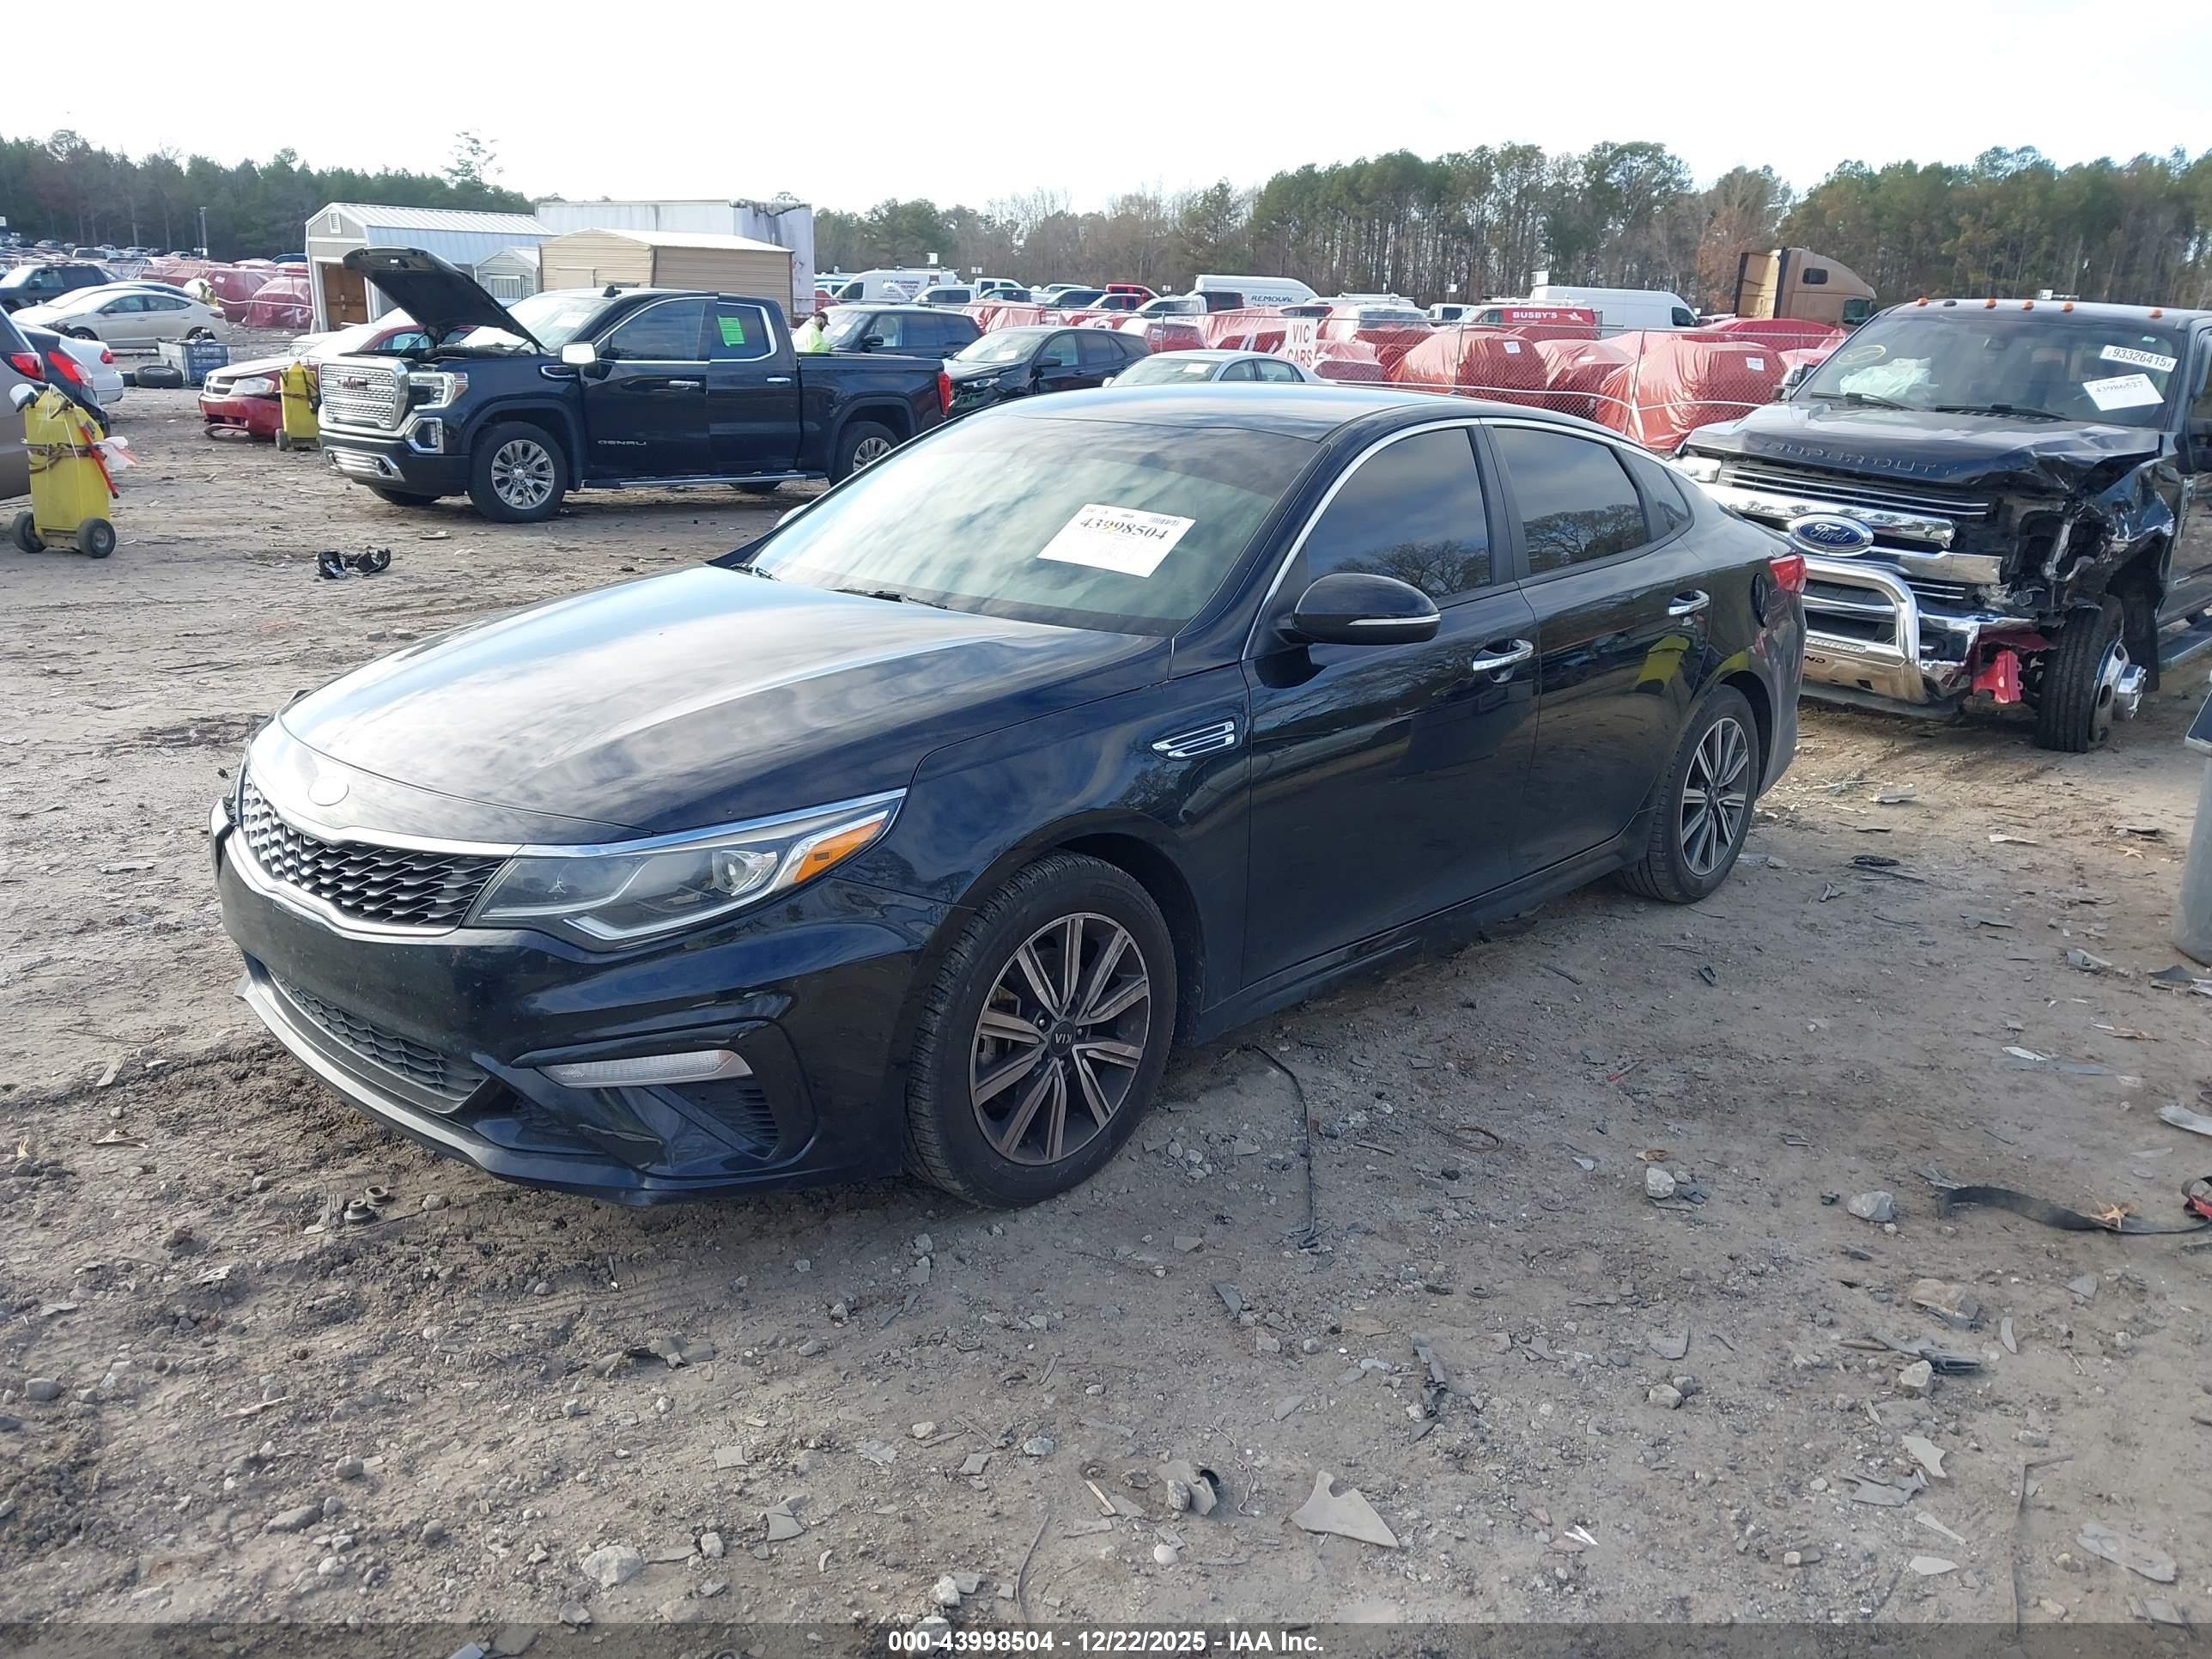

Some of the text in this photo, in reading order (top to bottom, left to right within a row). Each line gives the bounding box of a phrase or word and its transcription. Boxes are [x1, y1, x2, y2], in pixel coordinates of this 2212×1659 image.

[1250, 295, 1295, 303] REMOVAL
[1512, 311, 1558, 319] BUSBY'S
[1292, 324, 1310, 343] VIC
[1286, 348, 1313, 368] CARS
[2112, 348, 2168, 368] 93326415
[1080, 517, 1169, 540] 43998504
[1809, 523, 1850, 544] Ford
